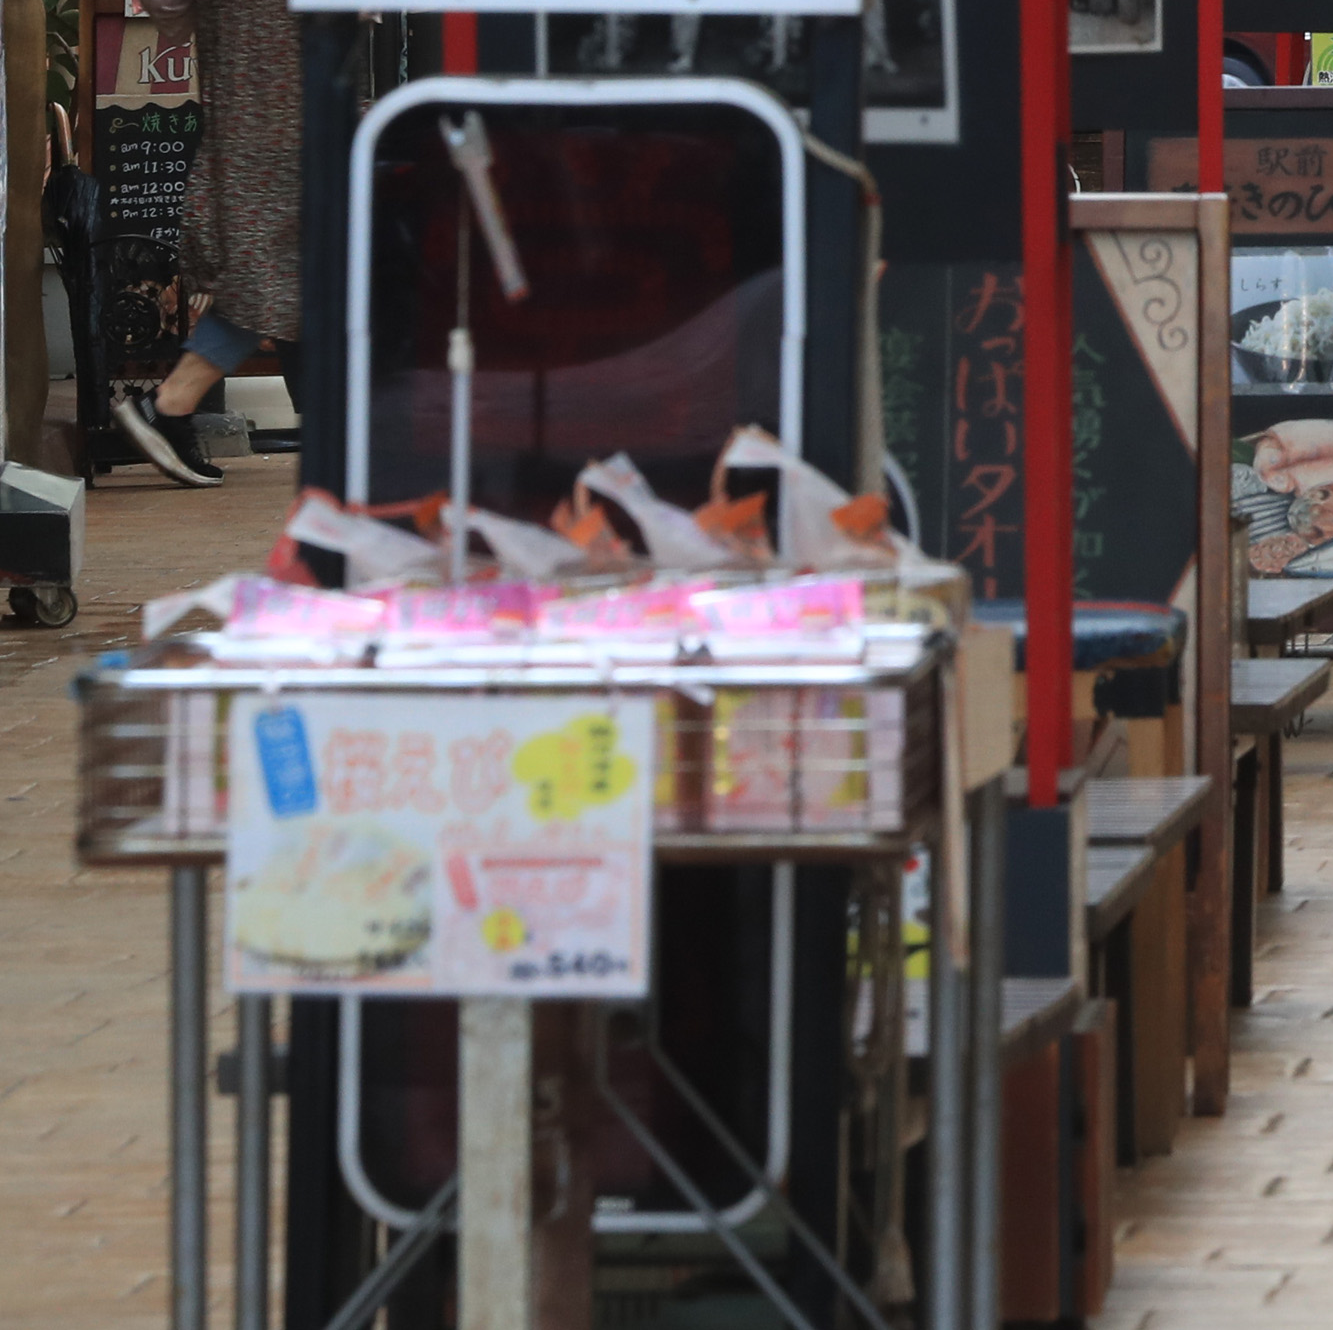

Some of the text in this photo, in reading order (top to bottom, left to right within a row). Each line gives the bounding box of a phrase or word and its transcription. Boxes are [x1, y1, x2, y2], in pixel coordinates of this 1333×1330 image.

[120, 141, 185, 156] am 9:00
[122, 160, 187, 174] am 11:30
[120, 181, 185, 194] am 12:00
[1241, 278, 1283, 292] しらす
